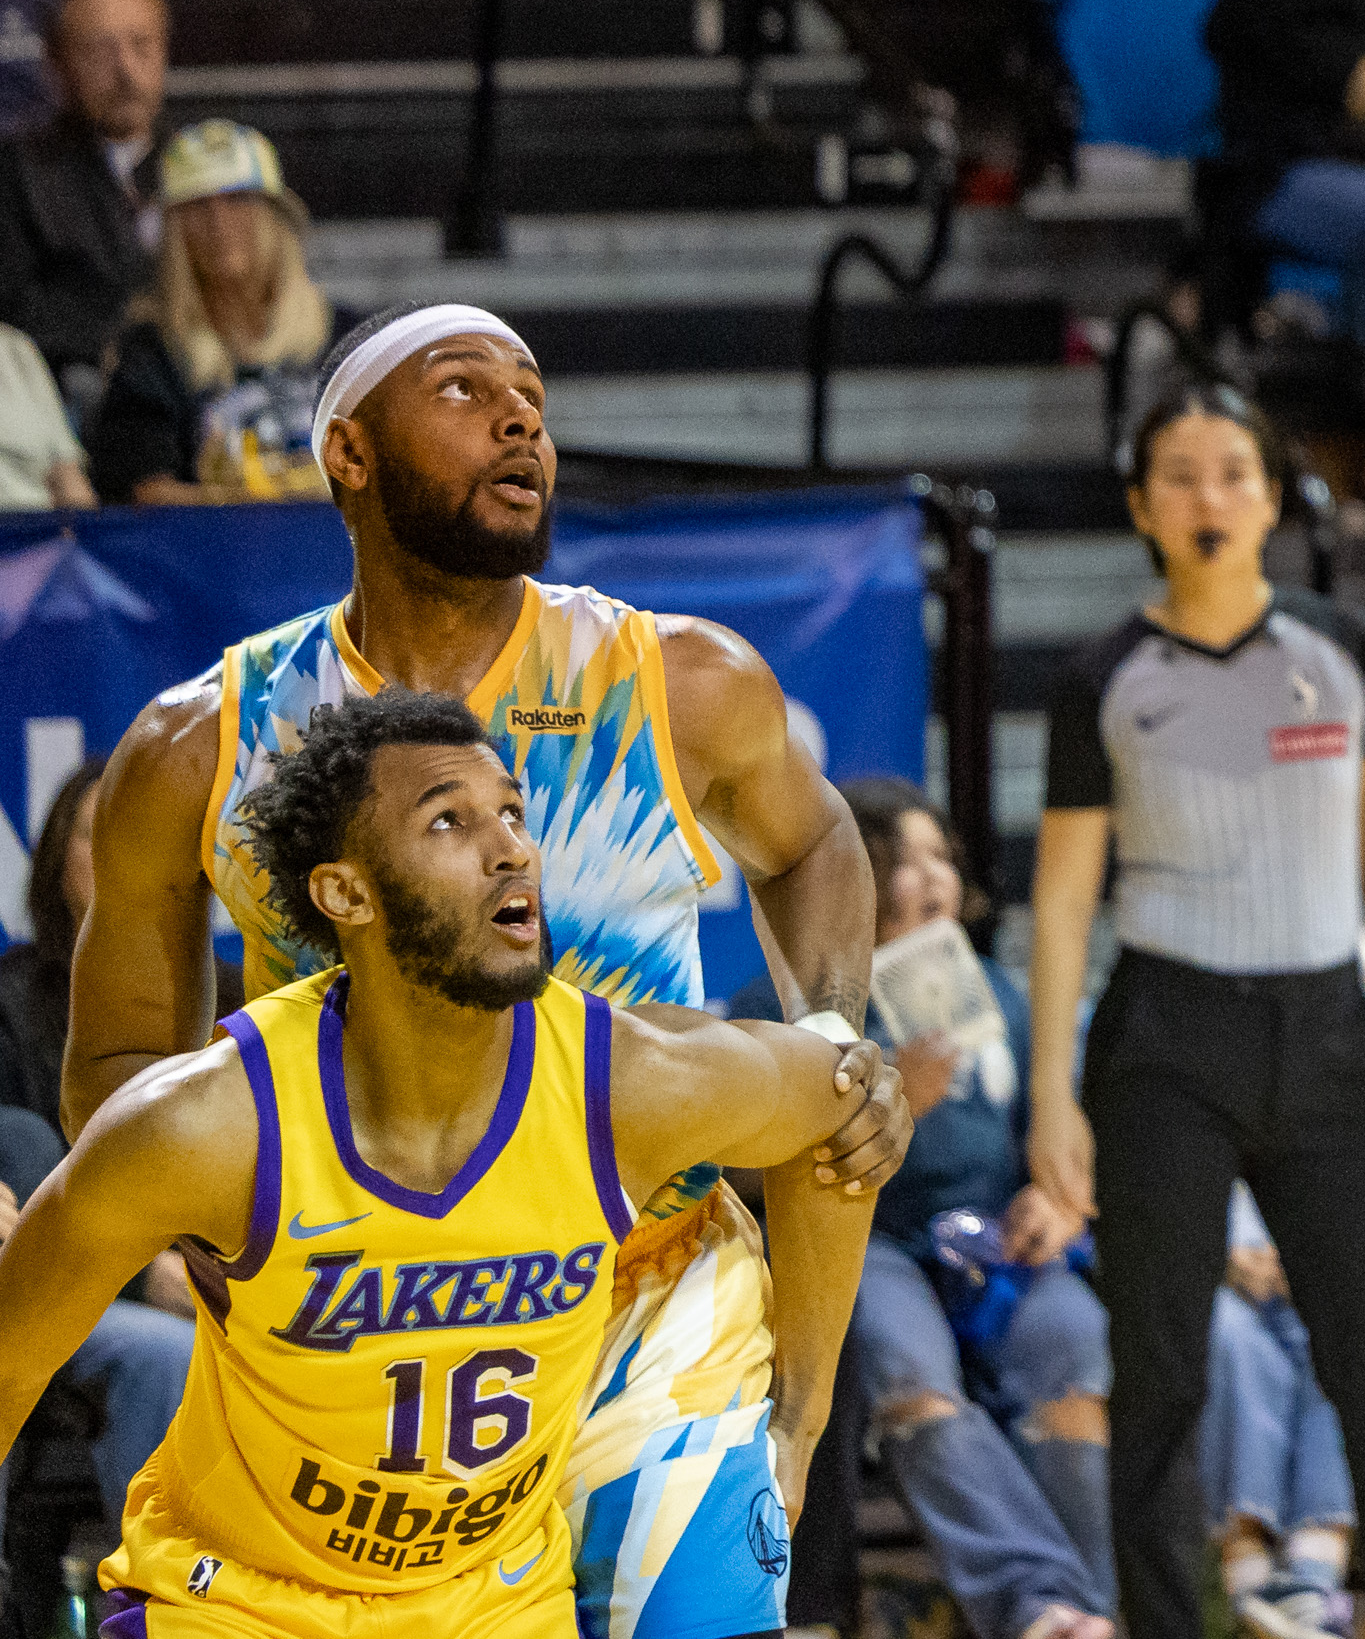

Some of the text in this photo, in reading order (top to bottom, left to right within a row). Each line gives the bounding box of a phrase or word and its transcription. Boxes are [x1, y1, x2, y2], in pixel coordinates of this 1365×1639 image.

[510, 708, 586, 728] Rakuten
[268, 1241, 607, 1353] LAKERS
[373, 1346, 541, 1482] 16
[290, 1453, 549, 1547] bibigo
[325, 1528, 444, 1572] 비비고
